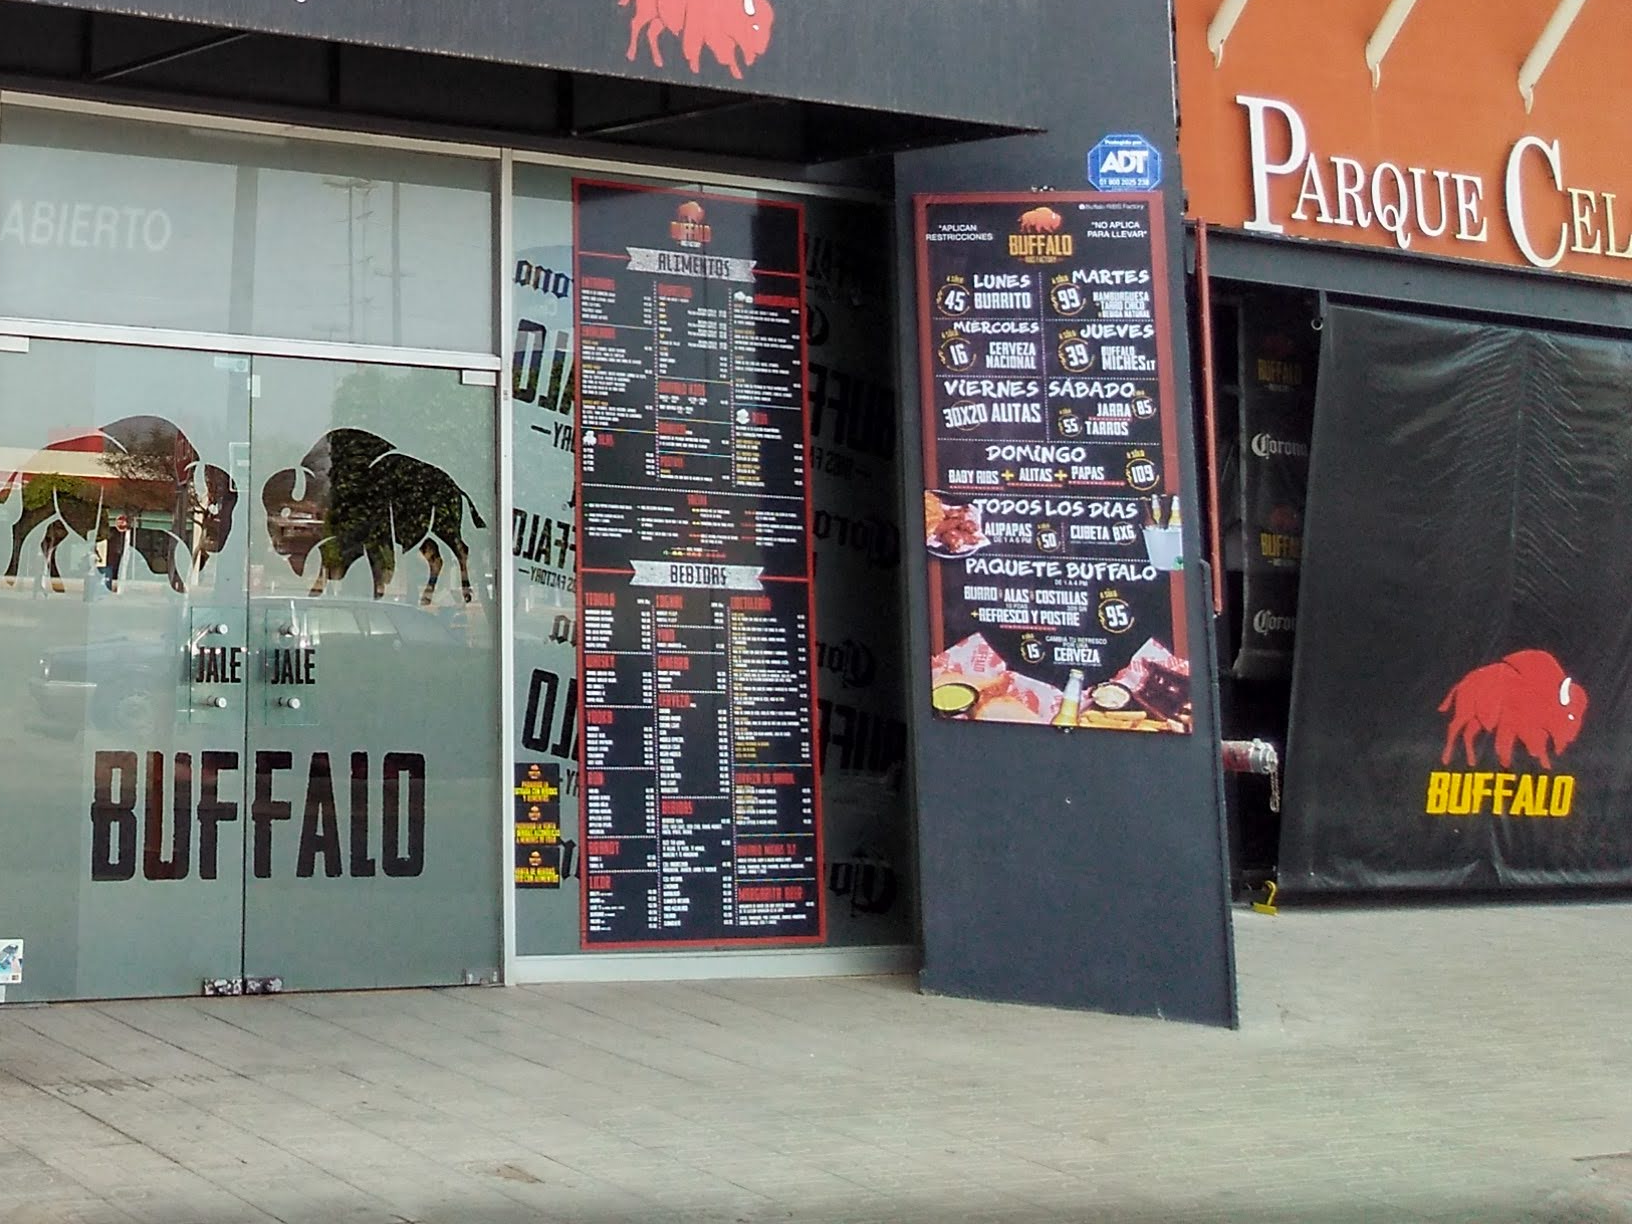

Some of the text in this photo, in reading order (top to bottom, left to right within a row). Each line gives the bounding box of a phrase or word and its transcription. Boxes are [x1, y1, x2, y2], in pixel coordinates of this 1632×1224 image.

[1099, 150, 1149, 174] ADT
[1235, 94, 1487, 250] PARQUE
[0, 198, 173, 252] ABIERTO
[1087, 230, 1110, 238] PARA
[1109, 221, 1140, 229] APLICA
[926, 233, 994, 241] RESTRICCIONES
[1009, 235, 1072, 256] BUFFALO
[658, 253, 730, 276] ALIMENTOS
[973, 273, 1031, 289] LUNES
[1071, 269, 1150, 285] MARTES
[974, 292, 1032, 309] BURRITO
[1092, 291, 1150, 302] HAMBURGUESA
[1079, 323, 1155, 339] JUEVES
[949, 343, 968, 366] 16
[989, 341, 1036, 356] CERVEZA
[1100, 345, 1135, 356] BUFFALO
[985, 355, 1037, 369] NACIONAL
[944, 379, 1039, 398] VIERNES
[990, 403, 1041, 423] ALITAS
[1096, 403, 1132, 417] JARRA
[1084, 421, 1129, 436] TARROS
[985, 444, 1086, 463] DOMINGO
[948, 469, 974, 484] BABY
[1019, 467, 1052, 482] ALITAS
[1071, 466, 1105, 480] PAPAS
[972, 498, 1042, 515] TODOS
[1045, 500, 1085, 517] LOS
[984, 522, 1032, 536] ALIPAPAS
[1070, 525, 1110, 540] CUBETA
[670, 565, 727, 585] BEBIDAS
[965, 558, 1157, 581] PAQUETE BUFFALO
[964, 586, 997, 601] BURRO
[1004, 588, 1030, 603] ALAS
[1035, 589, 1088, 605] COSTILLAS
[1030, 610, 1039, 624] Y
[1041, 610, 1080, 626] POSTRE
[1105, 605, 1129, 627] 95
[1054, 647, 1100, 663] CERVEZA
[195, 646, 242, 684] JALE
[270, 647, 316, 685] JALE
[1427, 772, 1574, 816] BUFFALO
[91, 750, 426, 882] BUFFALO
